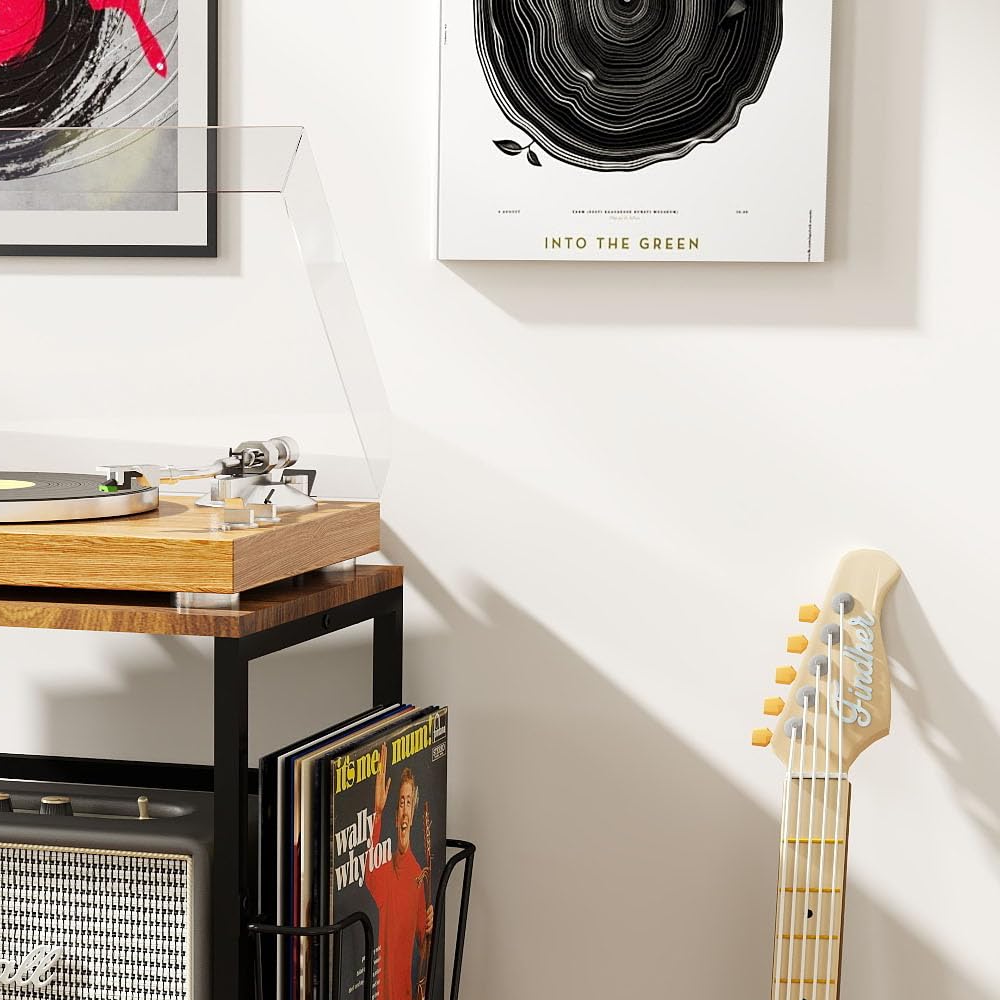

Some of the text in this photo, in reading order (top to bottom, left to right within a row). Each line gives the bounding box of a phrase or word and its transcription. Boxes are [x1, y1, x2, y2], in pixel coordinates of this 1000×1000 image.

[544, 237, 700, 250] INTO THE GREEN
[391, 713, 434, 766] mum!
[335, 808, 377, 857] wally
[335, 837, 392, 891] whyton
